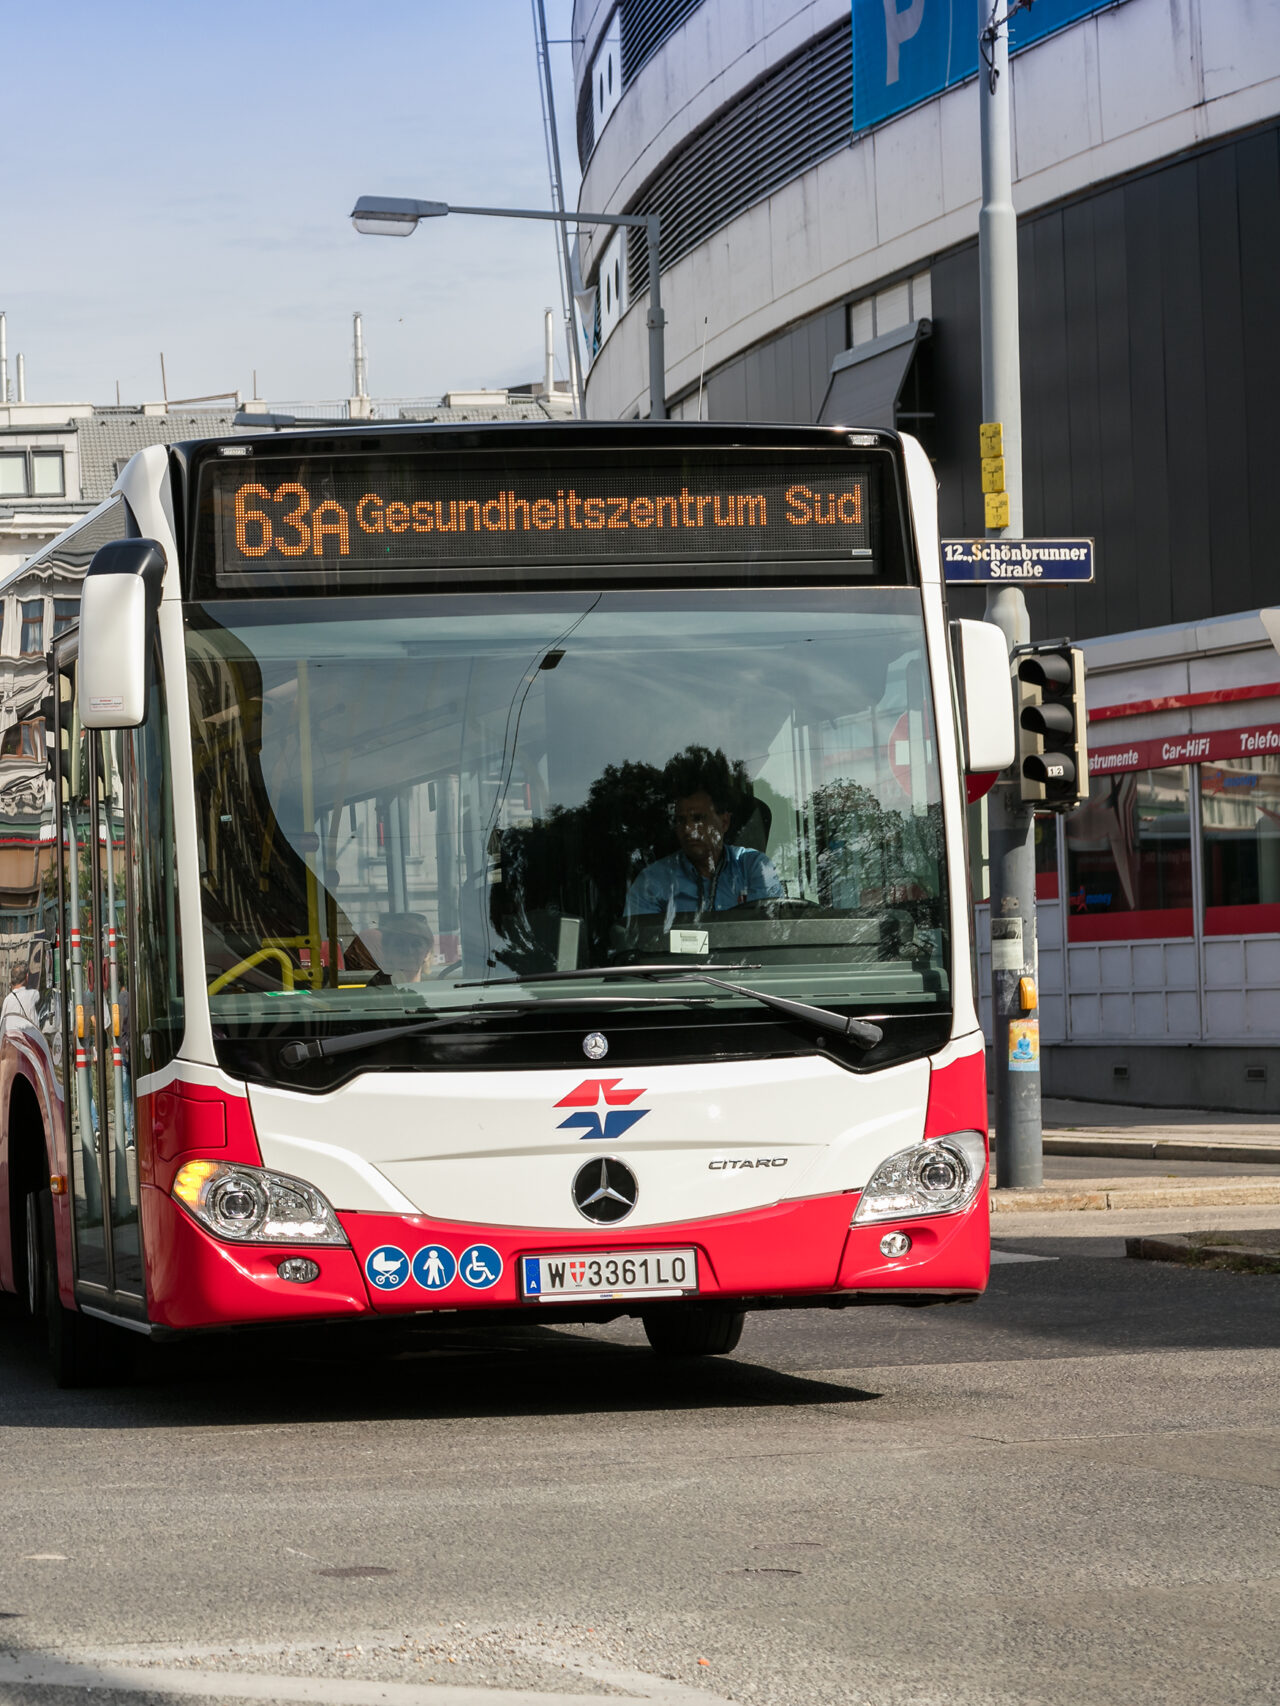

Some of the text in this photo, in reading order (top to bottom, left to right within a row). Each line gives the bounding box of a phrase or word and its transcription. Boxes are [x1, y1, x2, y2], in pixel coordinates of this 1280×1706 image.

[235, 483, 862, 556] 63A Gesundheitszentrum Süd
[990, 561, 1043, 577] Straße
[1162, 738, 1210, 760] Car-HiFi
[1240, 730, 1280, 751] Telefo
[708, 1158, 789, 1170] CITARO
[529, 1280, 538, 1289] A
[547, 1262, 566, 1288] W
